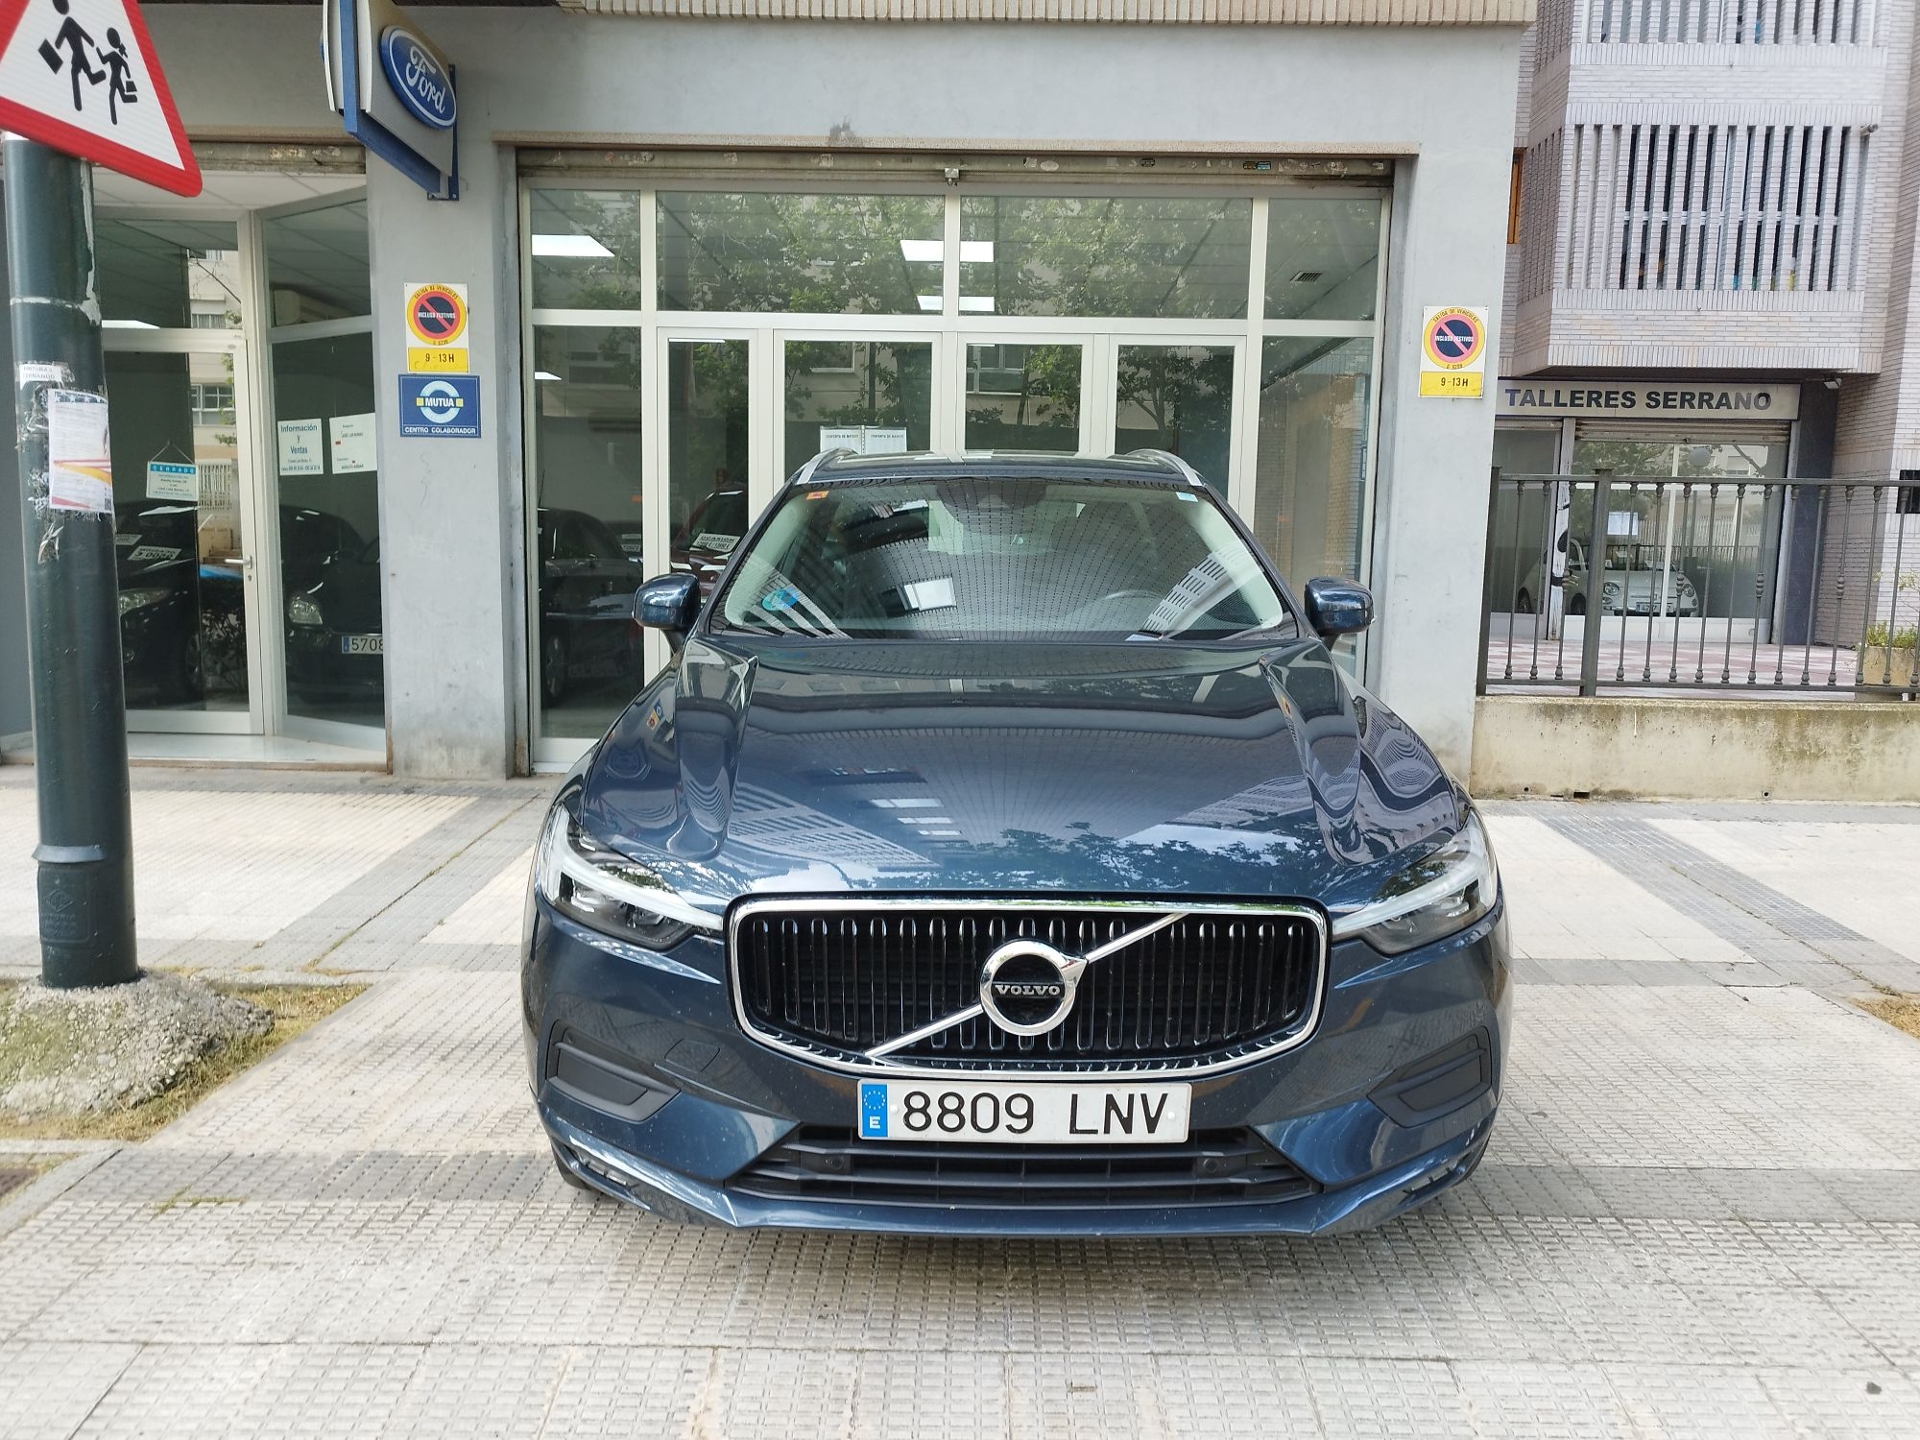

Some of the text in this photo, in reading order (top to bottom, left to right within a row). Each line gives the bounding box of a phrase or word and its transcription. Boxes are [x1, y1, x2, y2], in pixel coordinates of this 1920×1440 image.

[406, 46, 446, 114] Ford
[425, 397, 455, 407] MUTUA
[1505, 389, 1771, 411] TALLERES SERRANO
[280, 423, 318, 433] Información
[290, 445, 308, 454] Ventas
[994, 984, 1061, 996] VOLVO
[903, 1090, 1169, 1135] 8809 LNV
[869, 1116, 881, 1129] E
